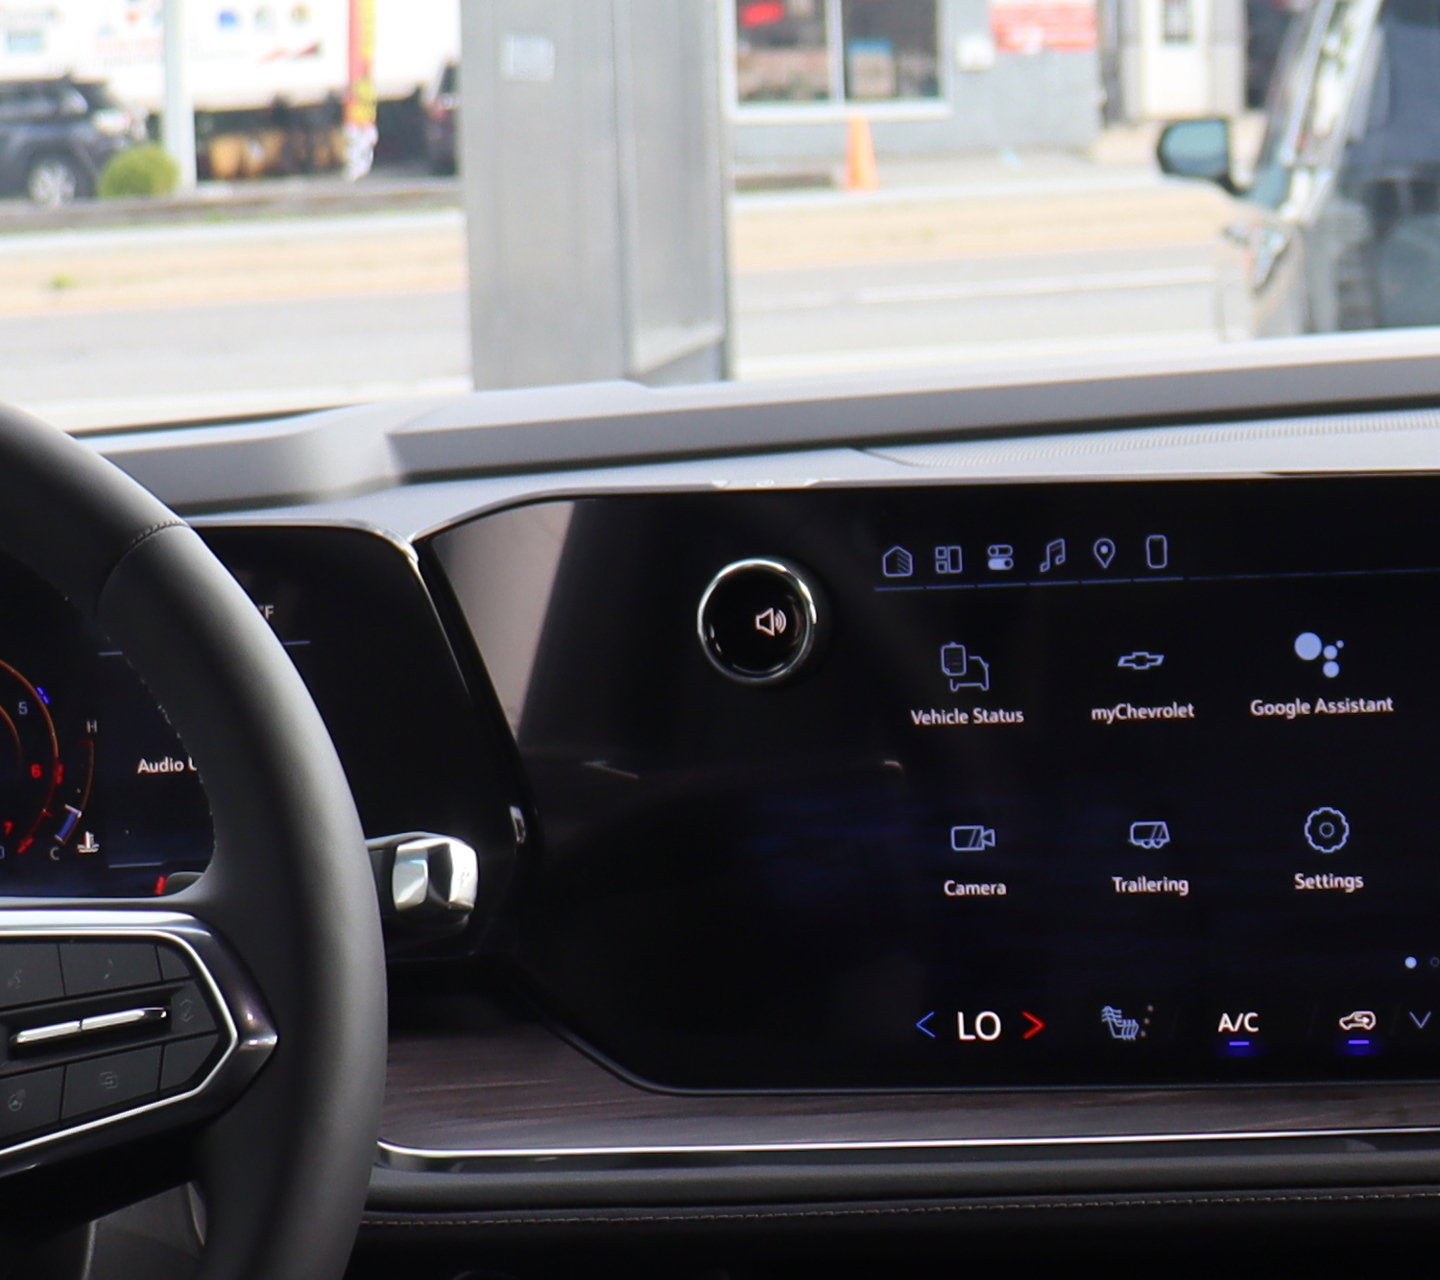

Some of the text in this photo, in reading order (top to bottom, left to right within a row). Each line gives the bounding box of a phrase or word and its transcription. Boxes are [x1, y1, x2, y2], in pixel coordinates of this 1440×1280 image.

[18, 701, 28, 715] 5
[910, 706, 1024, 726] Vehicle Status
[1090, 702, 1195, 723] myChevrolet
[1250, 695, 1394, 720] Google Assistant
[86, 720, 98, 734] H
[30, 763, 42, 778] 6
[137, 756, 185, 774] Audio
[3, 819, 14, 835] 7
[943, 878, 1007, 897] Camera
[1112, 875, 1190, 897] Trailering
[1294, 872, 1364, 894] Settings
[956, 1011, 1002, 1042] LO
[1217, 1012, 1259, 1034] A/C
